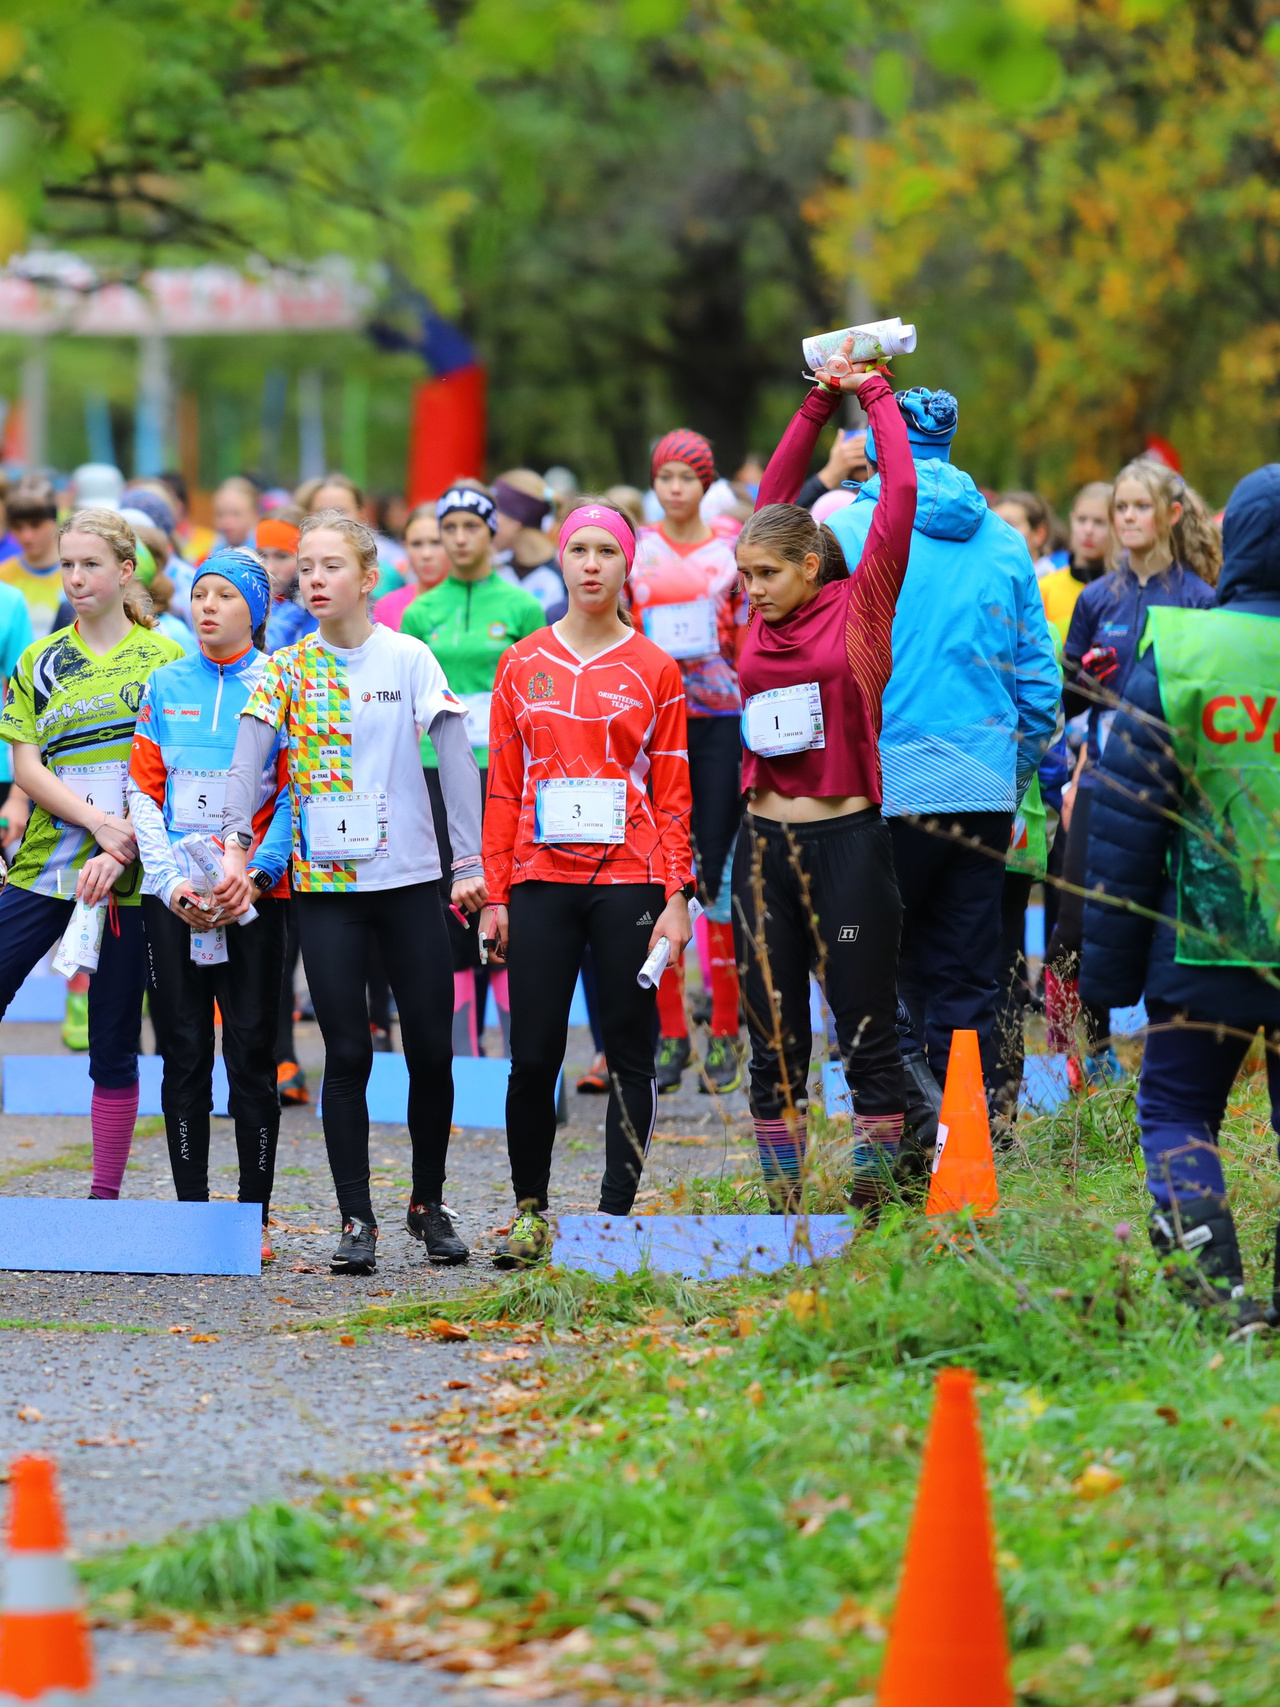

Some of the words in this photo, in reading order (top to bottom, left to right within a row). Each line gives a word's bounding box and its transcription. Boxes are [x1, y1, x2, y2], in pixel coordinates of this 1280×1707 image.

[597, 690, 644, 710] ORIENTEERING
[774, 715, 780, 730] 1
[1202, 694, 1280, 754] СУ
[197, 794, 207, 809] 5
[572, 803, 582, 819] 3
[337, 819, 347, 834] 4
[201, 952, 214, 961] 5.2
